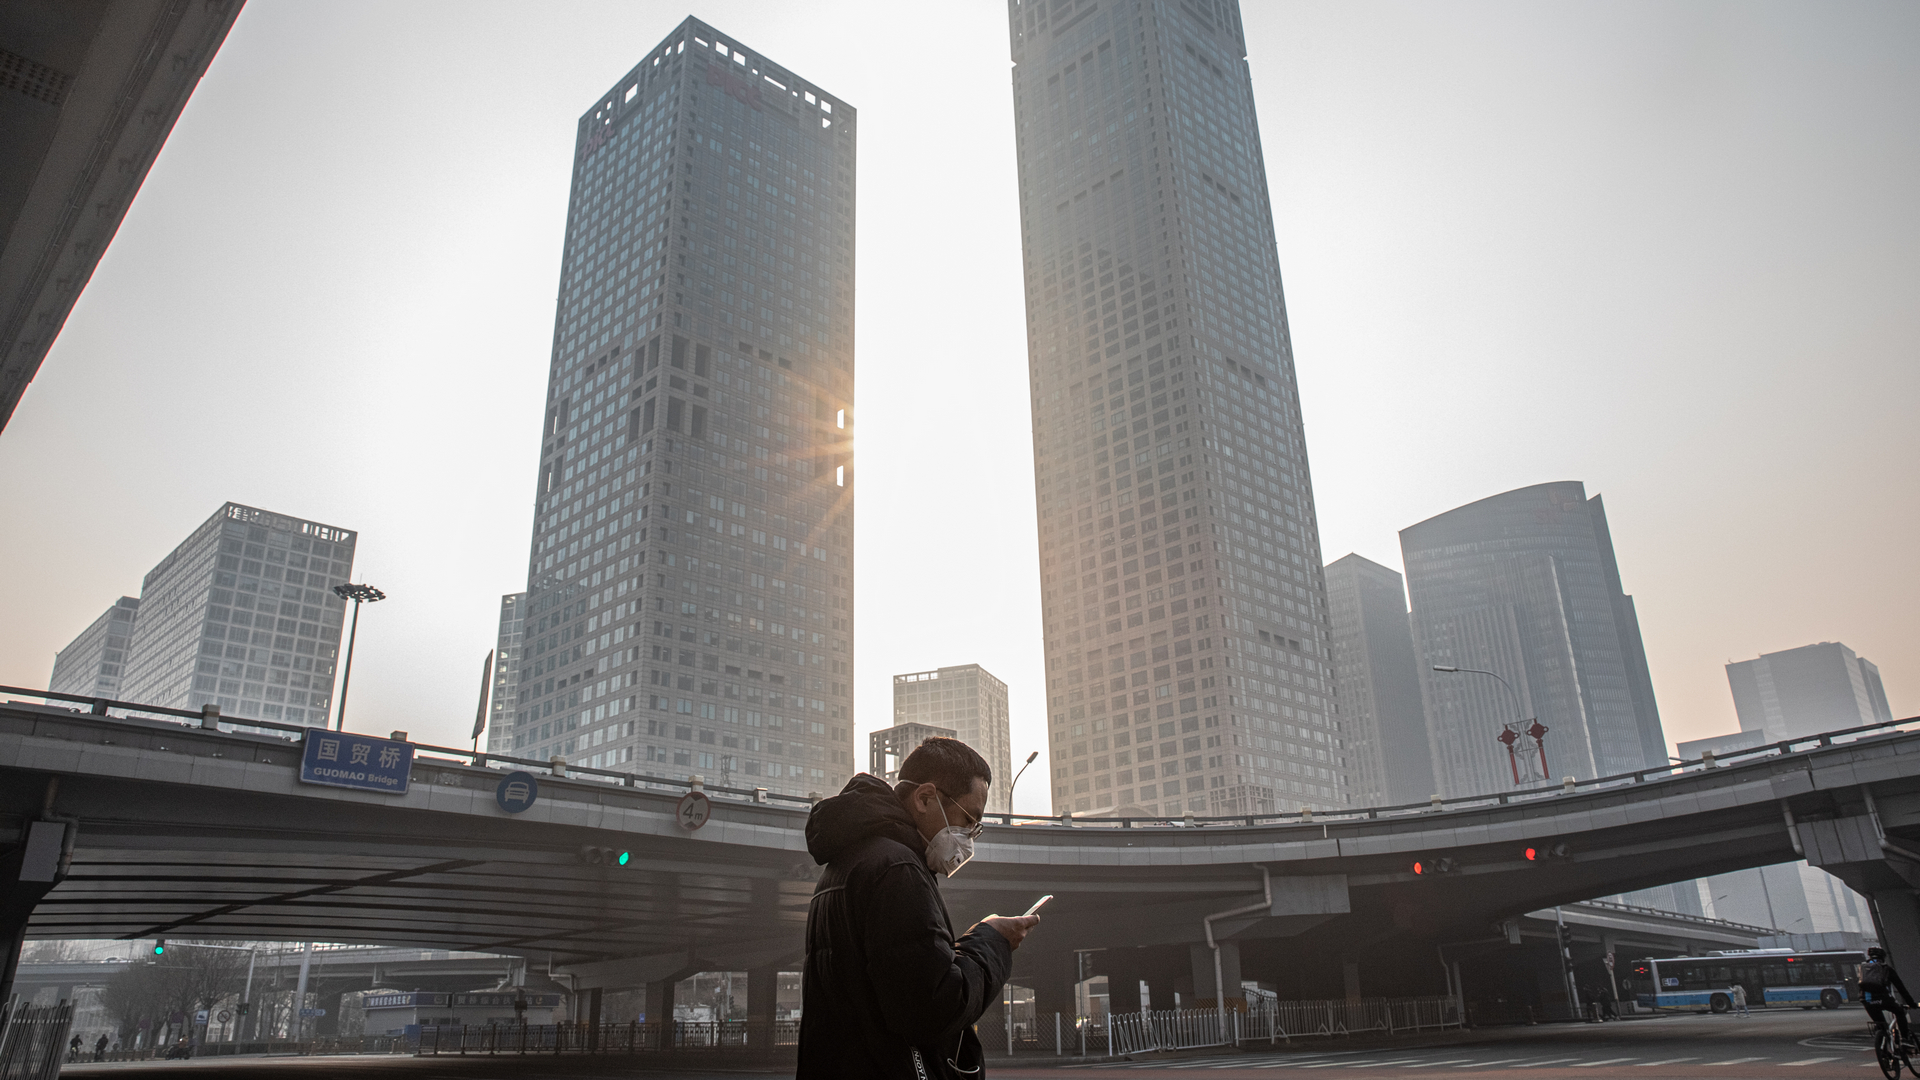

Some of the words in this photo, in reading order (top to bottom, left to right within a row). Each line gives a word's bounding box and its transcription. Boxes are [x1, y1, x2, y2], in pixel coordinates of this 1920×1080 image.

[317, 738, 400, 769] 国贸桥
[314, 767, 365, 780] GUOMAO
[368, 773, 399, 786] Bridge
